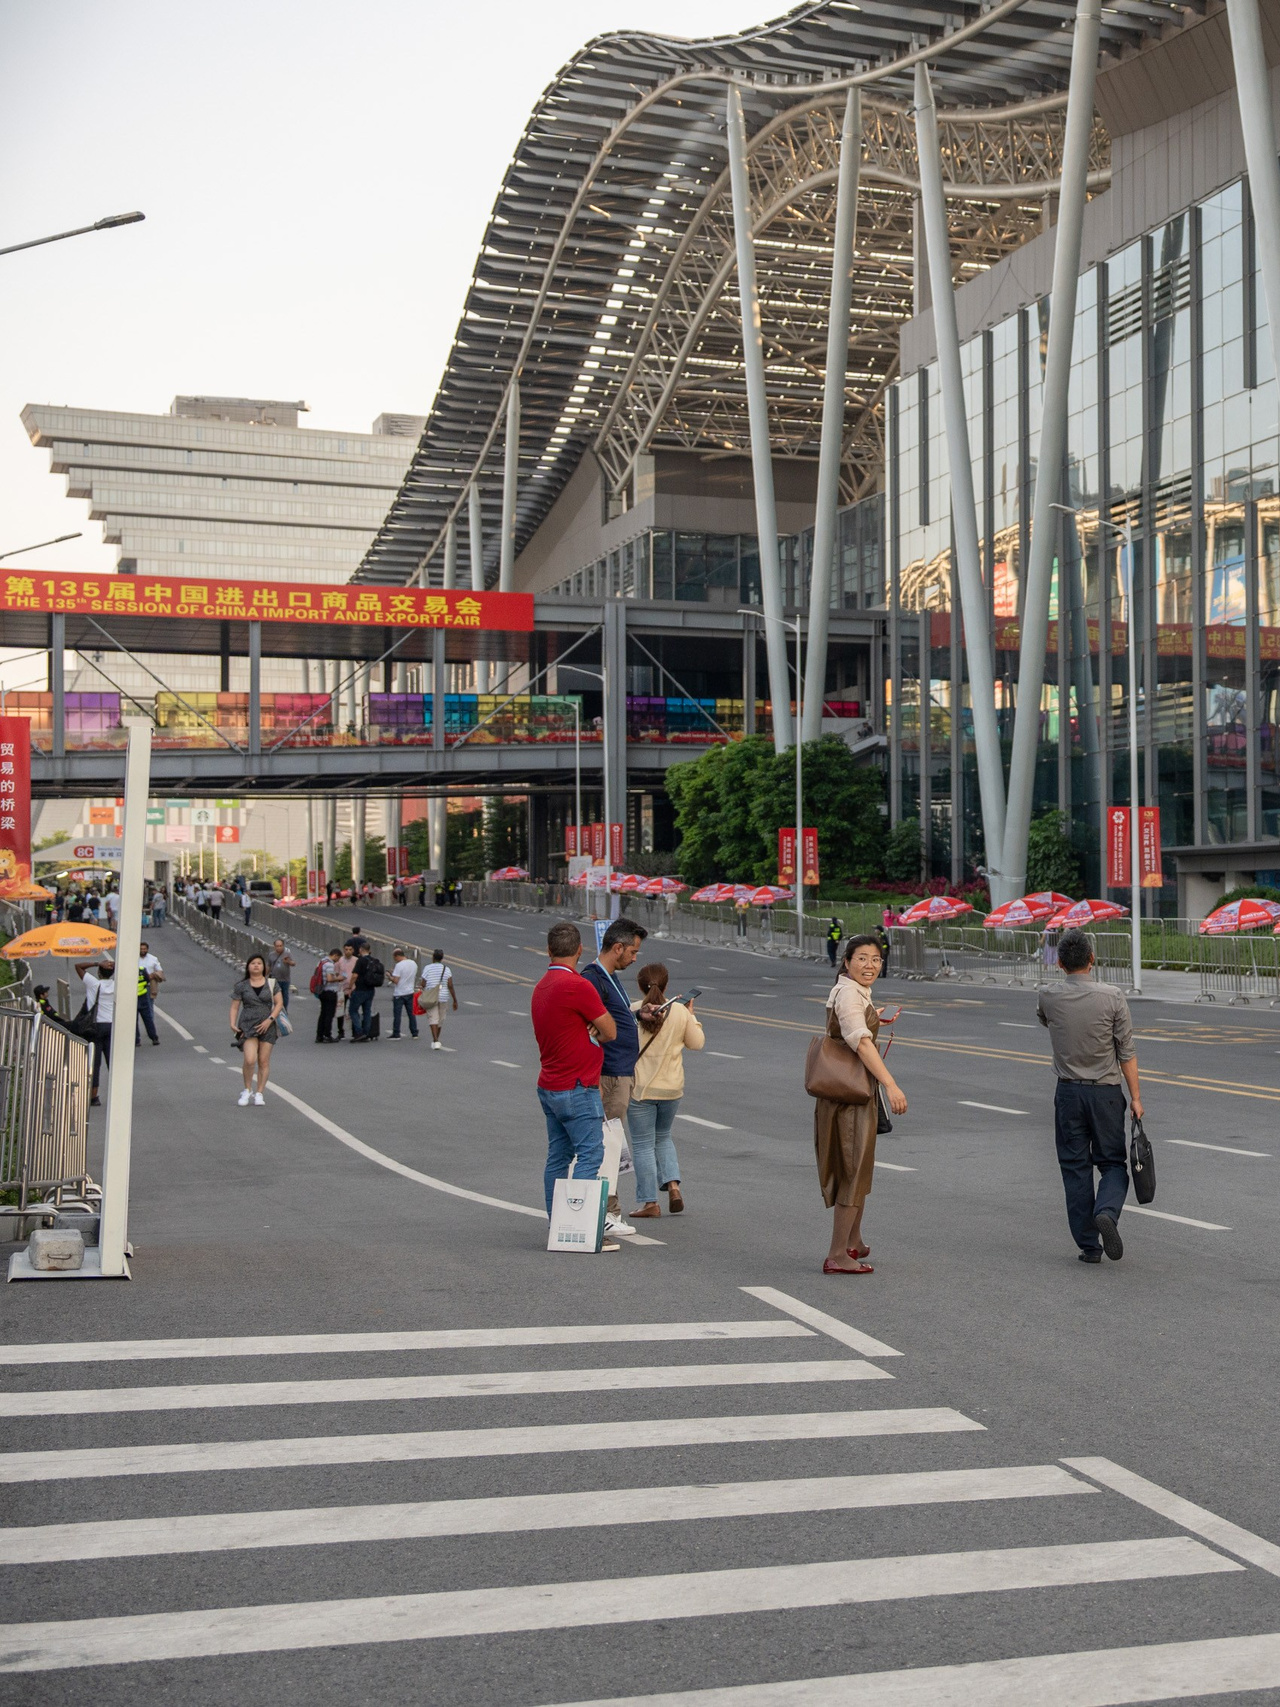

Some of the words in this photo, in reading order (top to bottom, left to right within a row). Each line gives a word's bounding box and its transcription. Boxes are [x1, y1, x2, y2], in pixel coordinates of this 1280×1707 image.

[4, 595, 40, 608] THE
[91, 599, 172, 614] SESSION
[176, 603, 200, 615] OF
[203, 604, 259, 617] CHINA
[263, 607, 330, 620] IMPORT
[334, 610, 371, 622] AND
[375, 612, 441, 624] EXPORT
[444, 614, 481, 626] FAIR
[5, 576, 482, 615] 第135届中国进出口商品交易会
[0, 743, 15, 830] 贸易的桥梁
[76, 847, 93, 858] 8C
